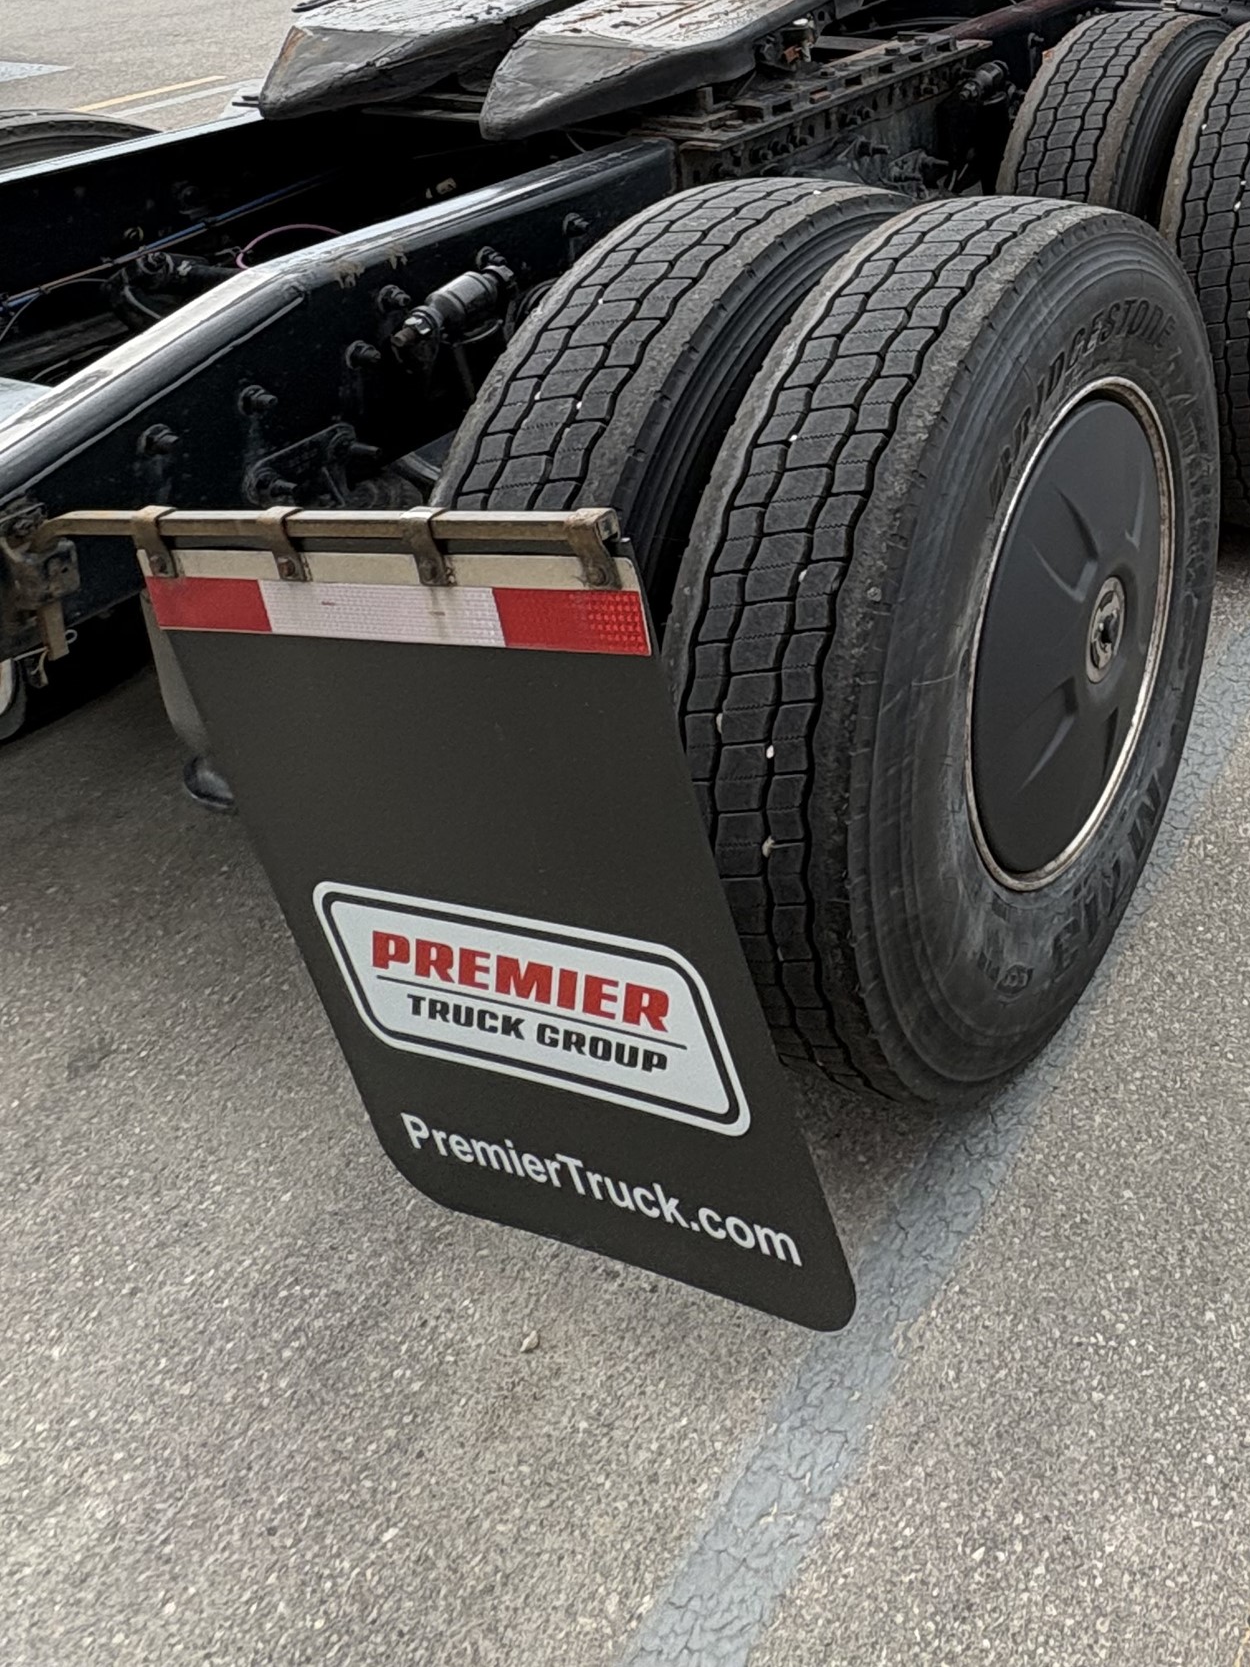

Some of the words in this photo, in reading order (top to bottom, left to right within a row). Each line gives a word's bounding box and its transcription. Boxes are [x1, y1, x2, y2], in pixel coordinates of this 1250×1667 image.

[989, 297, 1177, 510] BRIDGESTONE
[371, 929, 670, 1033] PREMIER
[407, 993, 526, 1040] TRUCK
[536, 1022, 669, 1073] GROUP
[401, 1112, 802, 1266] PremierTruck.com
